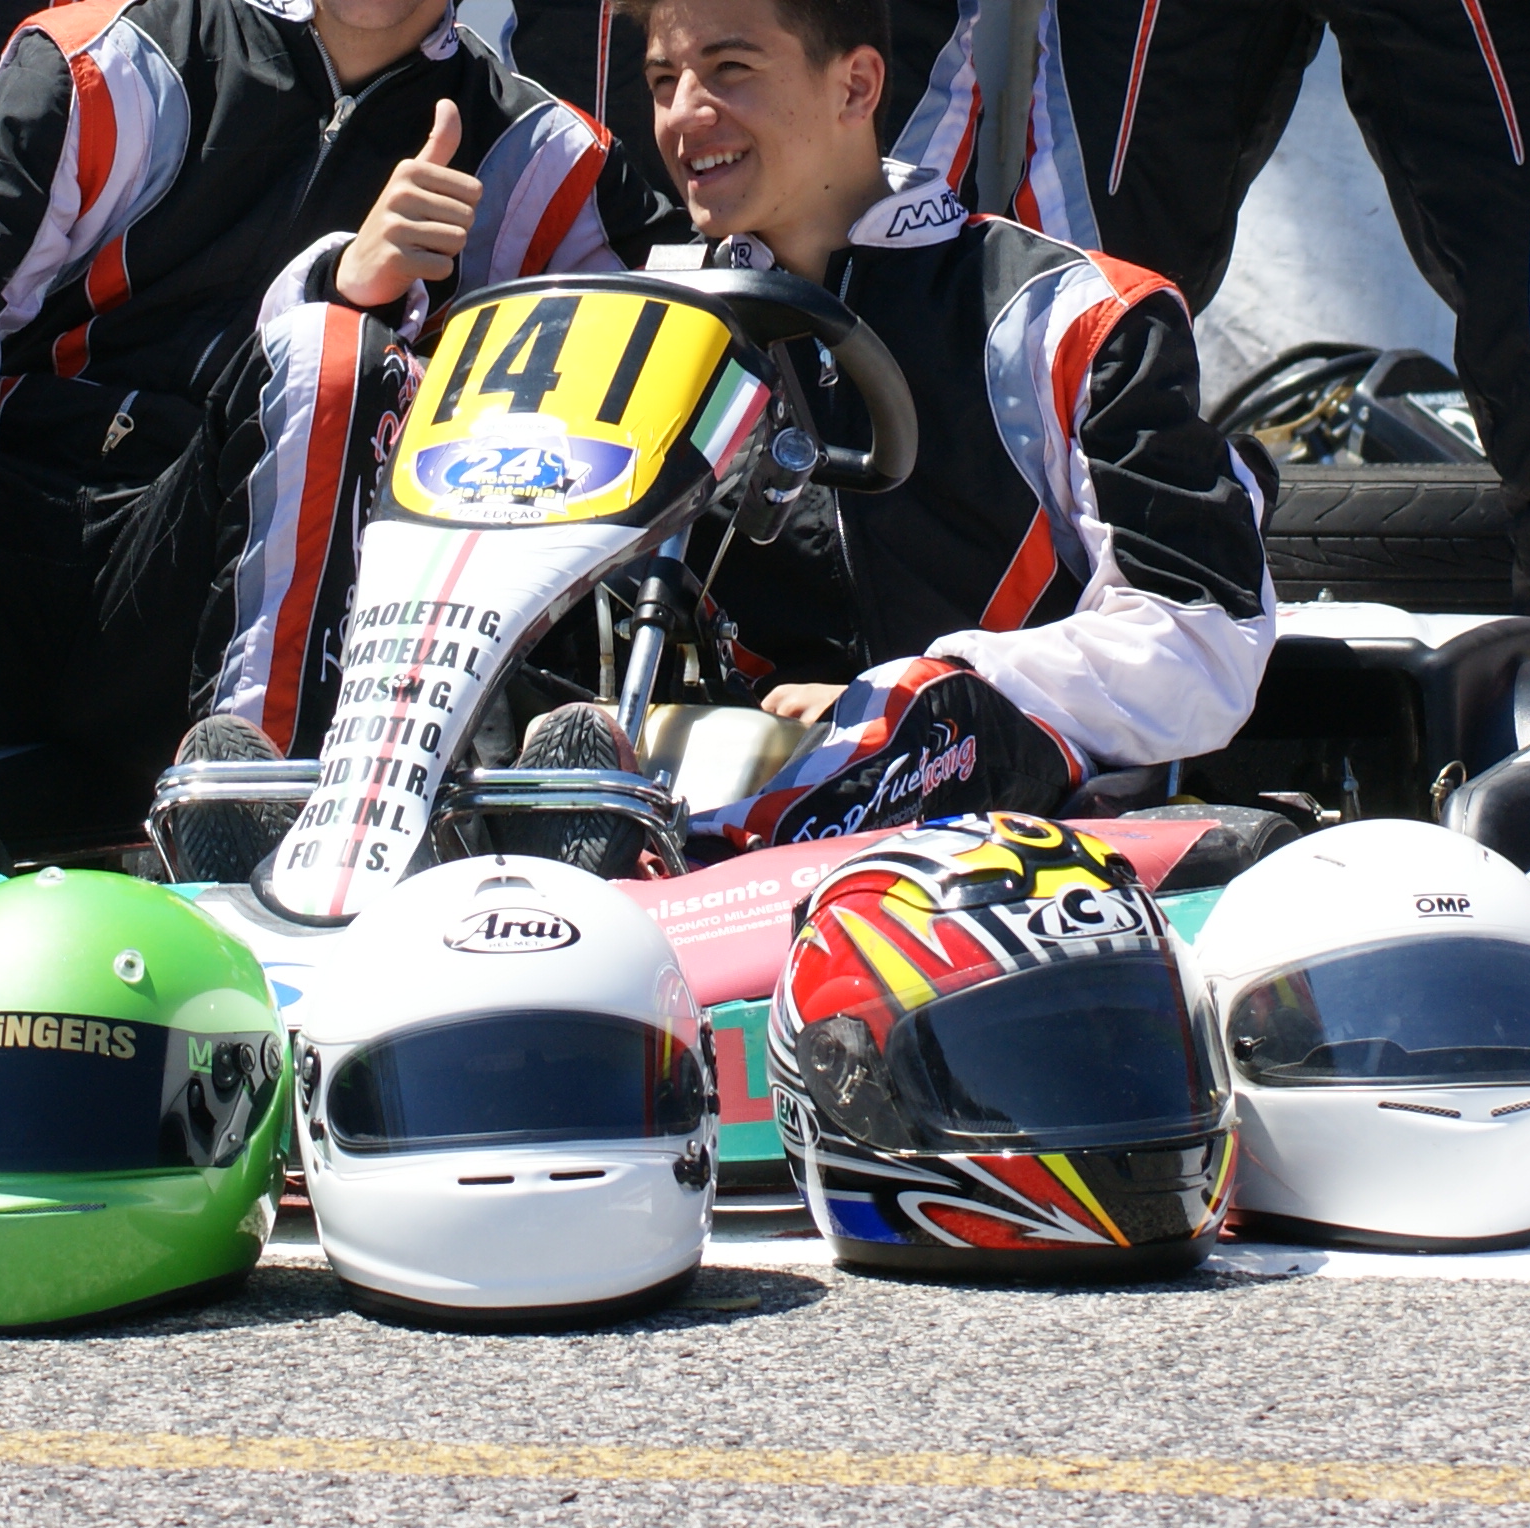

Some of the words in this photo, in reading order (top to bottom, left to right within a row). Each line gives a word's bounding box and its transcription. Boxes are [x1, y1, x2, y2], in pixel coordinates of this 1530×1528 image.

[431, 295, 671, 426] 141
[458, 447, 542, 484] 24
[354, 600, 473, 636] PAOLETTI
[477, 609, 502, 643] G.
[463, 646, 482, 682] L.
[427, 680, 454, 714] G.
[320, 756, 402, 788] IDTI
[405, 762, 429, 802] R.
[390, 804, 412, 836] L.
[365, 841, 391, 873] S.
[1415, 897, 1471, 913] OMP
[454, 913, 565, 947] Arai
